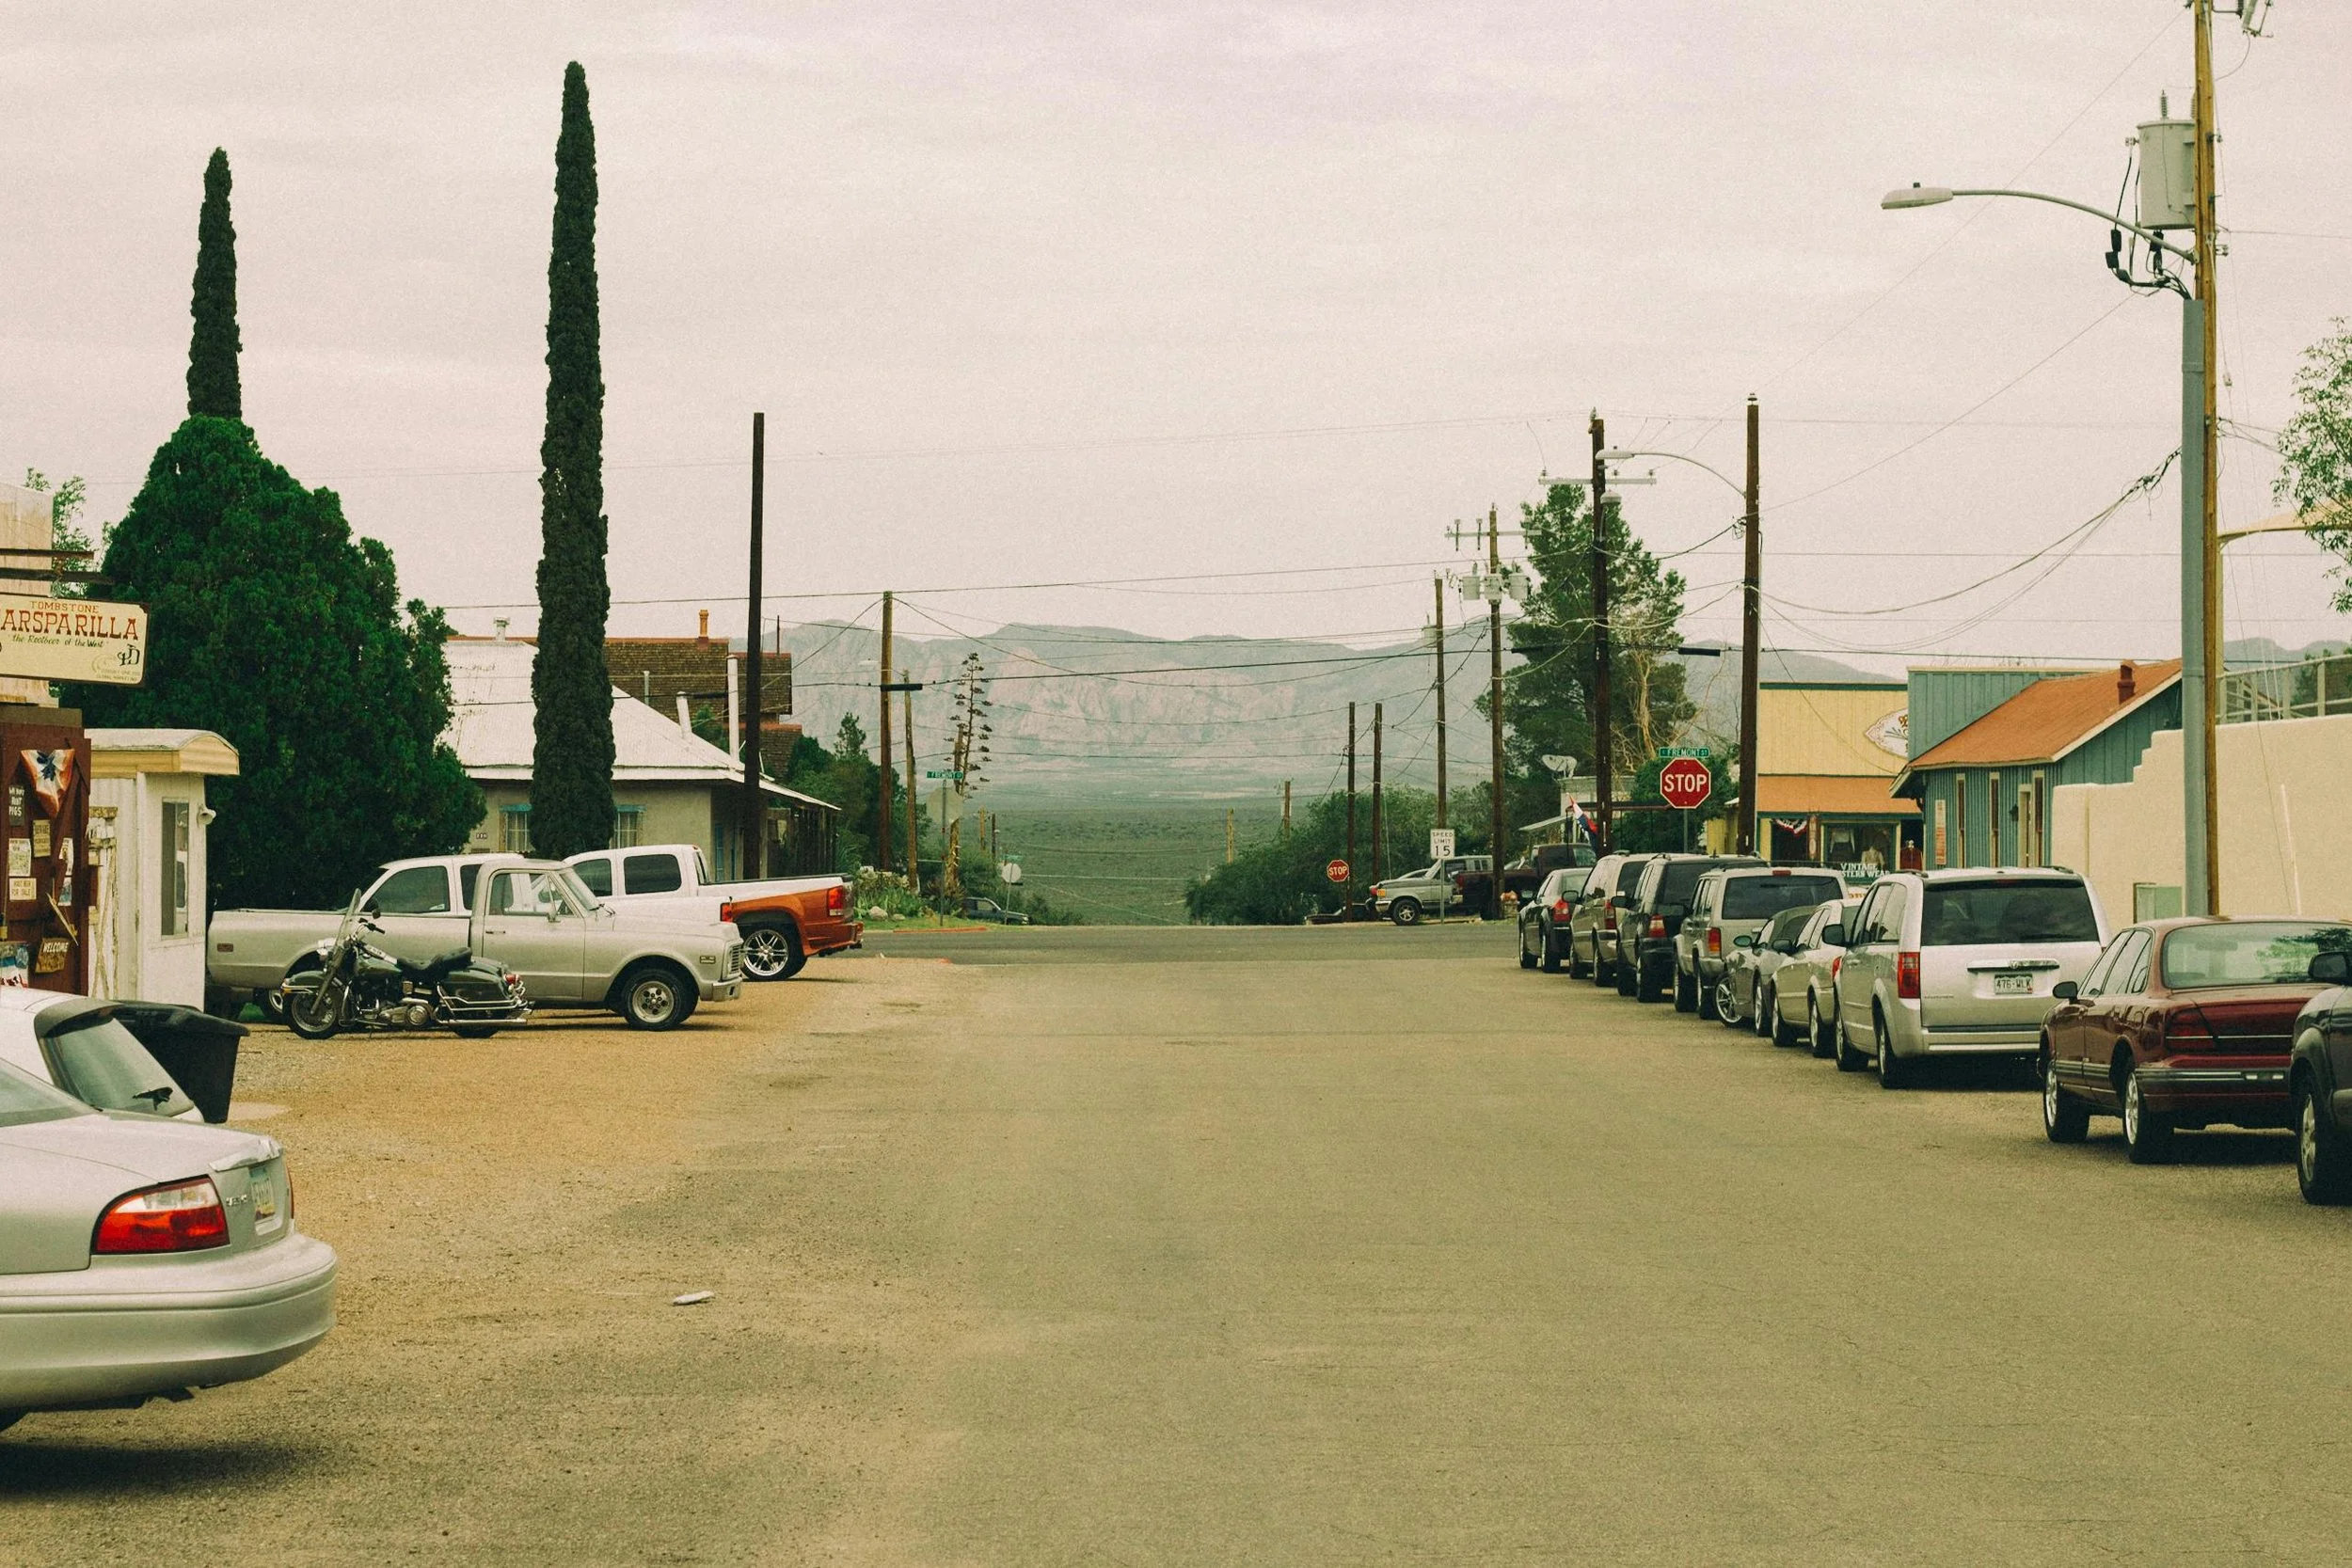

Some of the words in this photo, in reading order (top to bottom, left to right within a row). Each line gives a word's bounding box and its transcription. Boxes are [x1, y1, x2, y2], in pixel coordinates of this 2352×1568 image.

[30, 601, 99, 613] TOMBSTONE
[0, 609, 139, 641] ARSPARILLA
[1667, 748, 1699, 757] FREMONT
[1663, 773, 1708, 793] STOP
[1435, 845, 1451, 857] 15
[1328, 865, 1347, 876] STOP
[1840, 863, 1879, 871] VINTAGE
[42, 942, 70, 953] WELCOME
